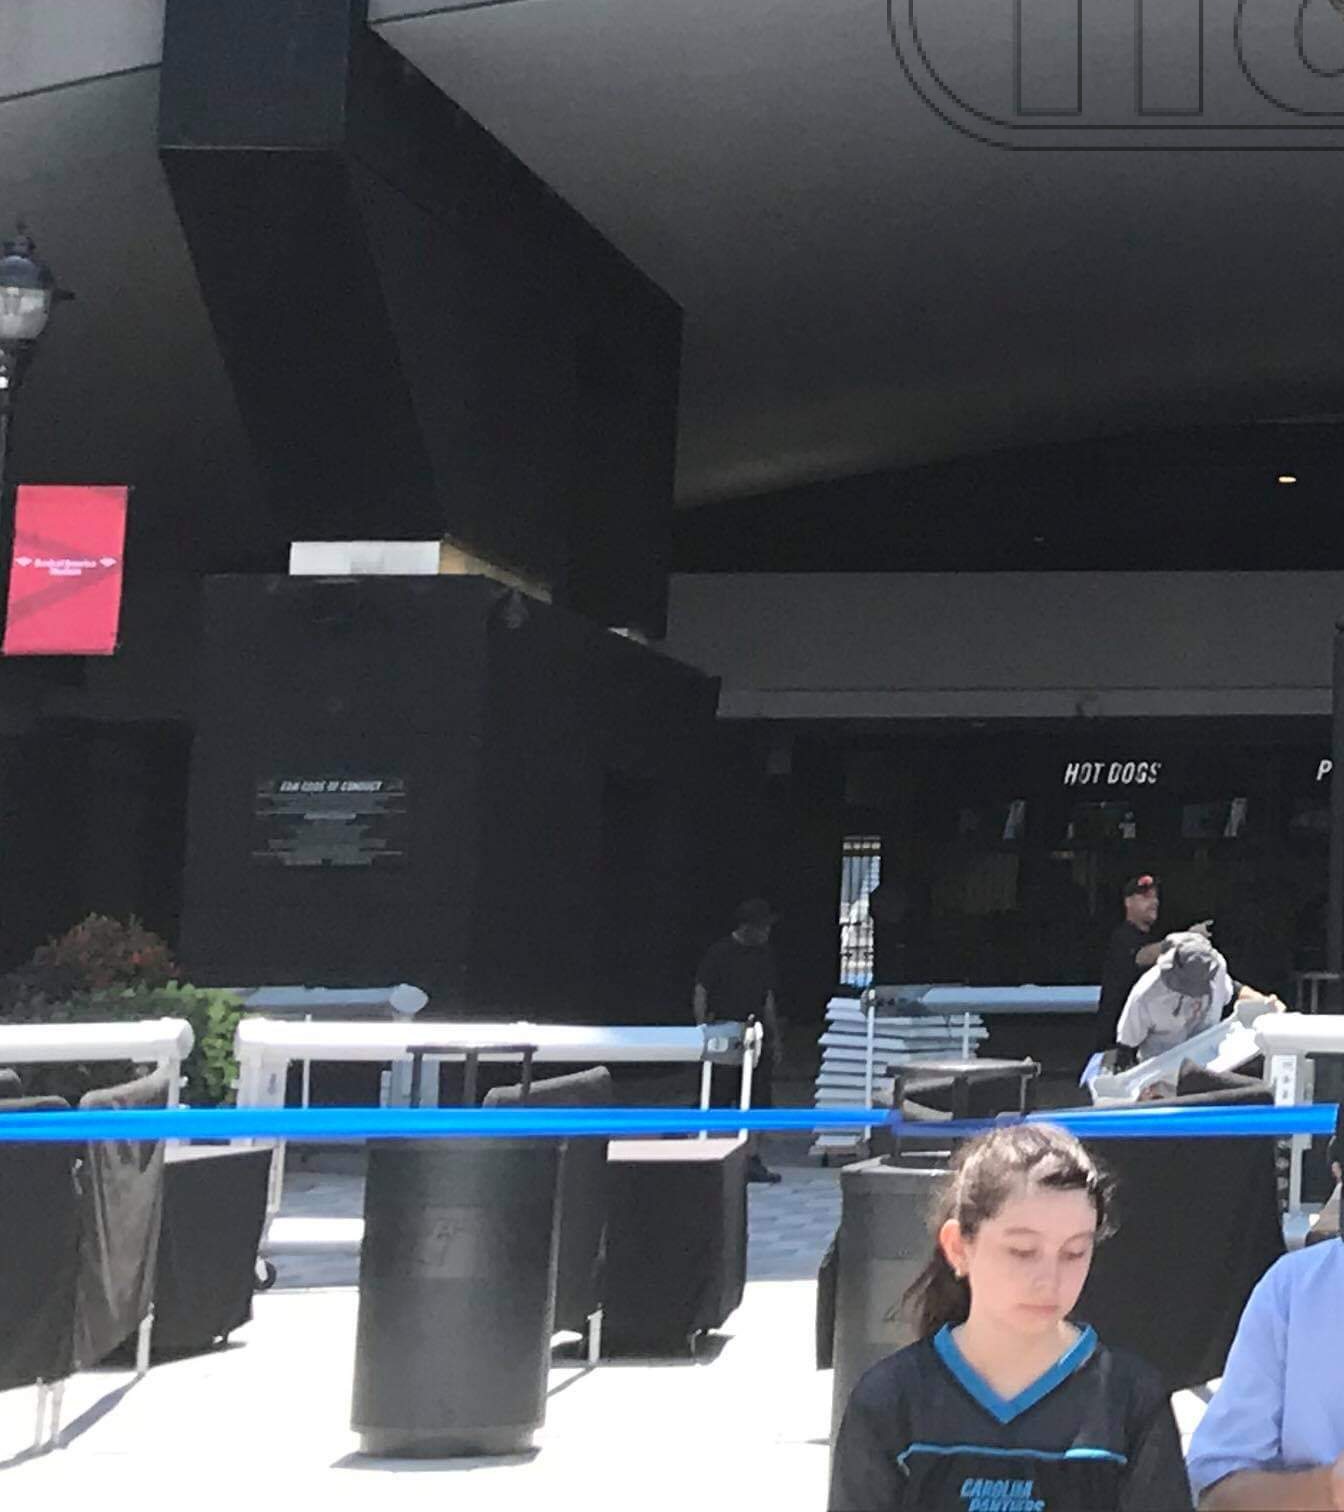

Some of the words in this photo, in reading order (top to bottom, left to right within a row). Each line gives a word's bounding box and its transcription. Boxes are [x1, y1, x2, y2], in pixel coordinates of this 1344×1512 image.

[1063, 761, 1105, 786] HOT
[1107, 761, 1162, 785] DOGS
[960, 1477, 1034, 1498] CAROLINA
